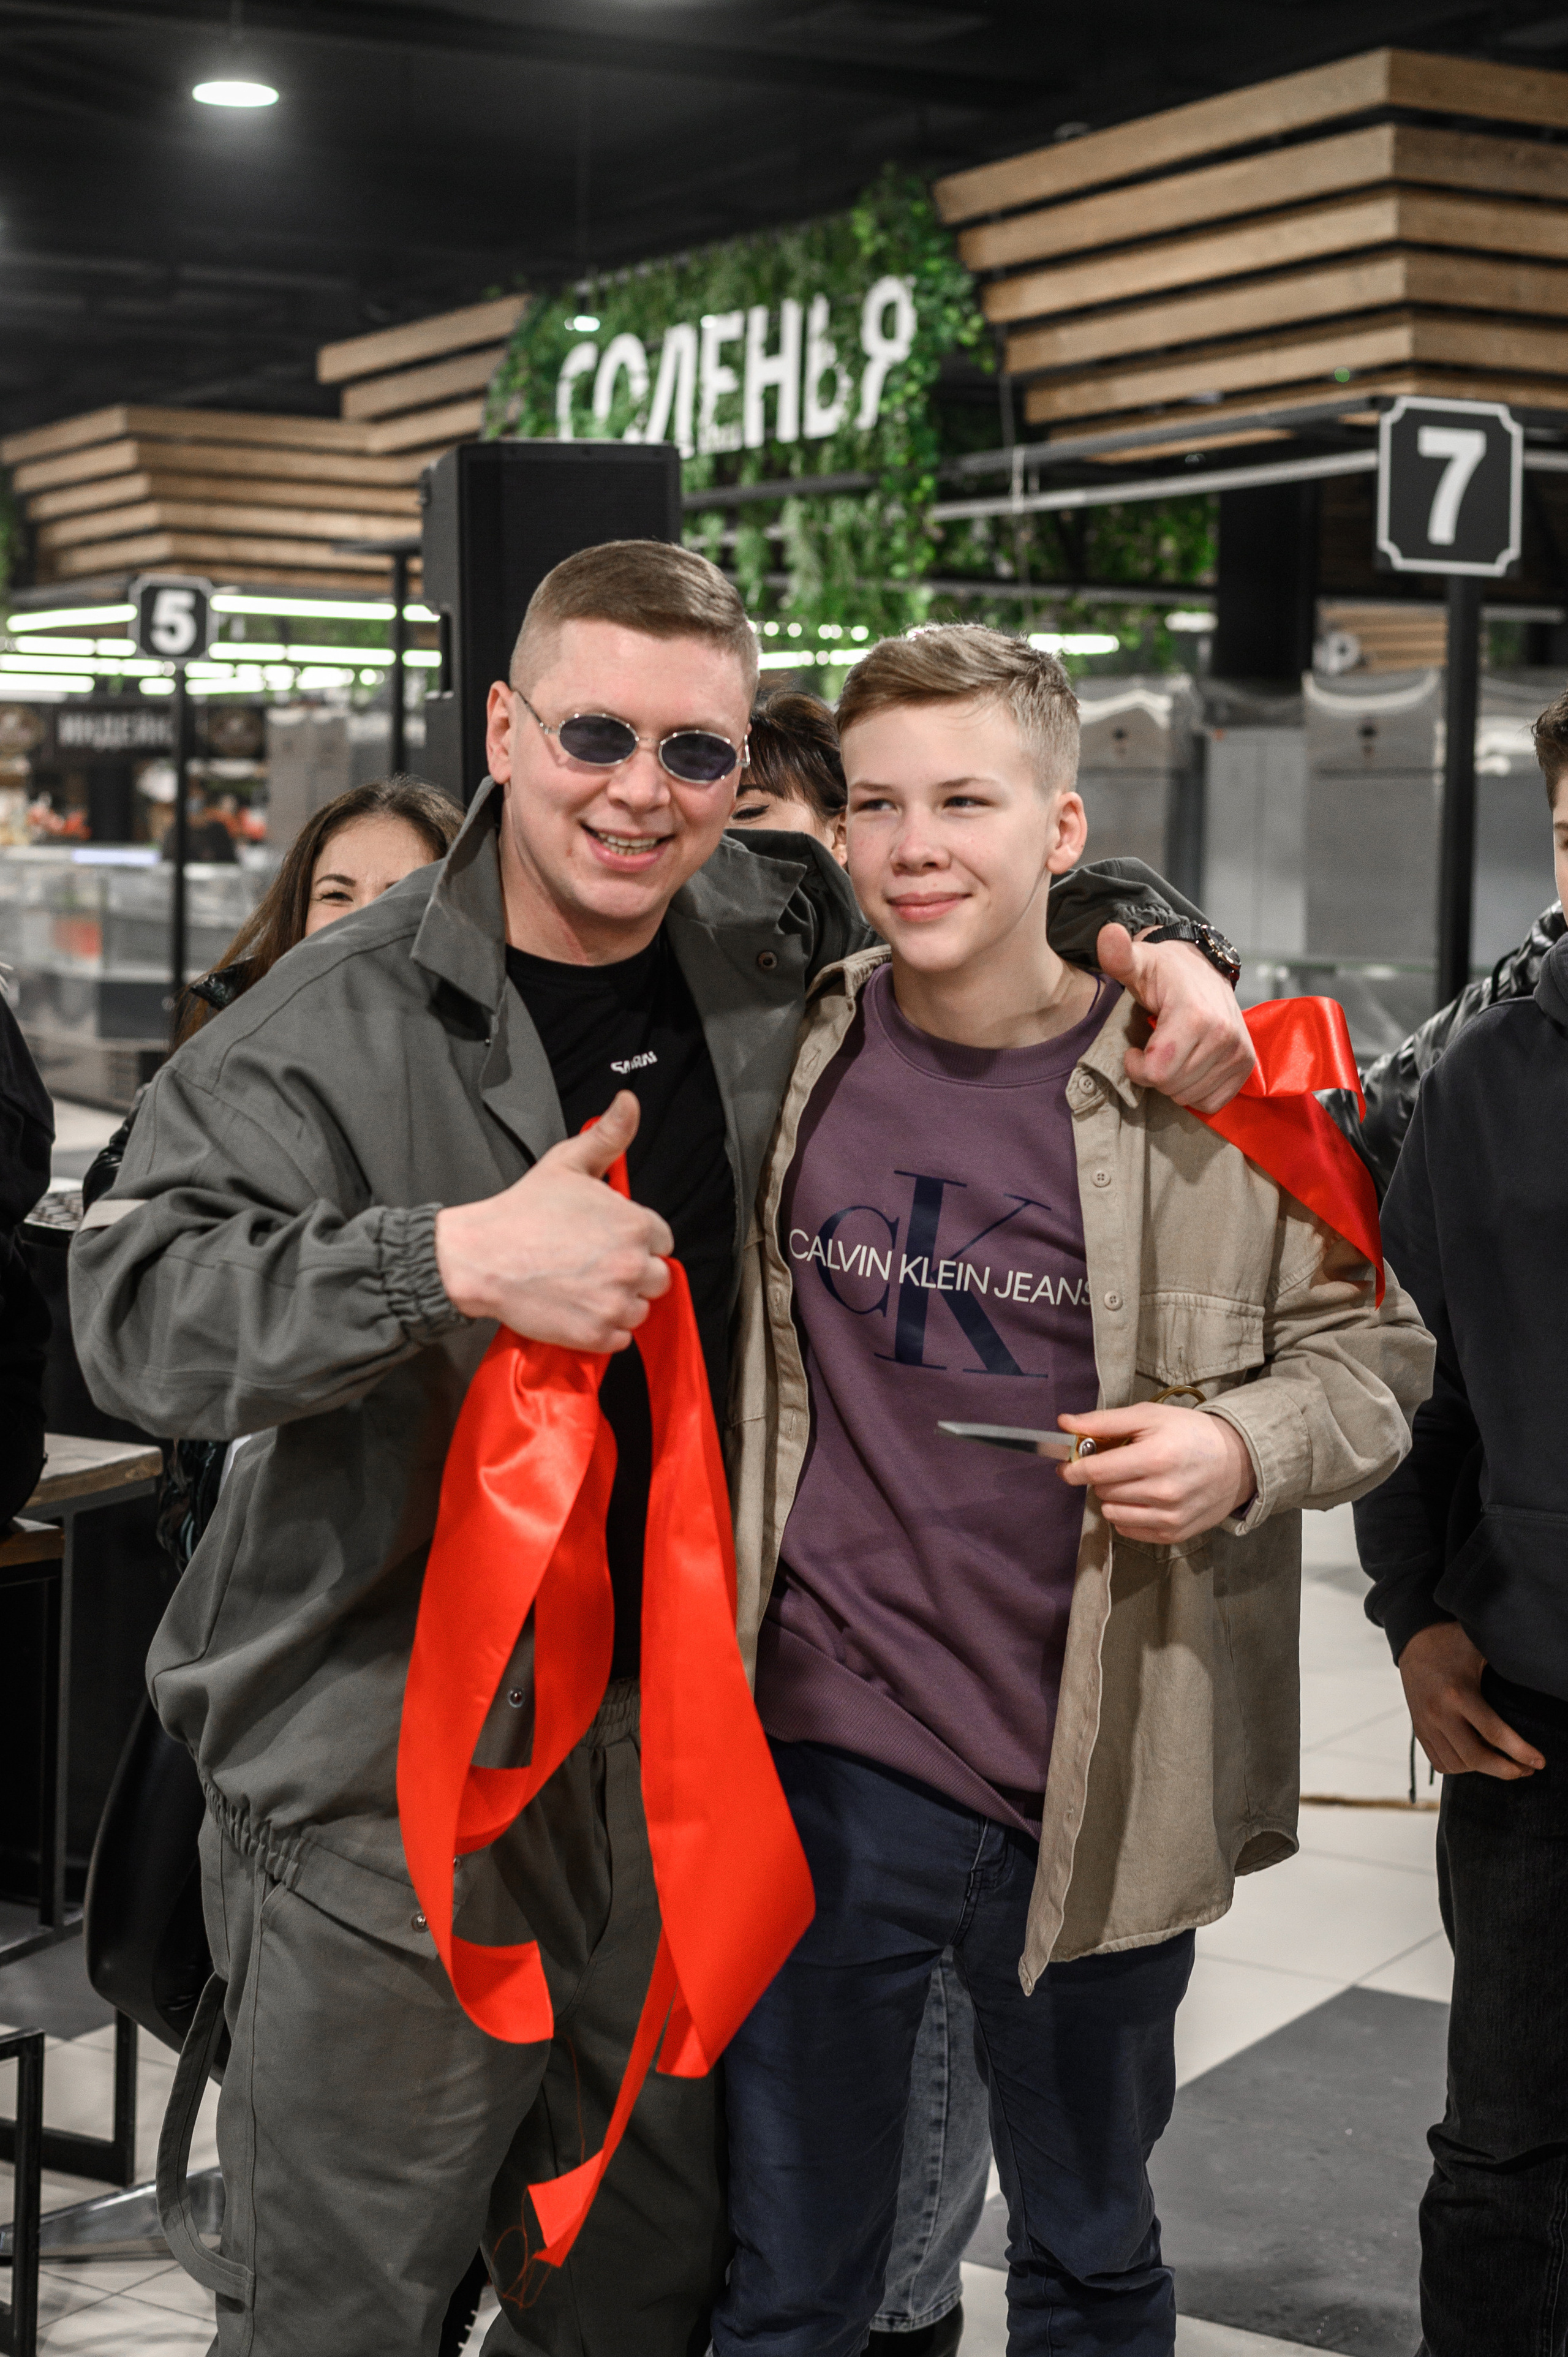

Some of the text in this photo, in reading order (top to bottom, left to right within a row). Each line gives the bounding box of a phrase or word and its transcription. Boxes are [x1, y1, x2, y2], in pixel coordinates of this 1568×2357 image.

[556, 274, 918, 459] СОЛЕНЬЯ
[1417, 425, 1487, 546] 7
[149, 589, 198, 656] 5
[788, 1228, 892, 1281] CALVIN
[899, 1253, 990, 1295] KLEIN
